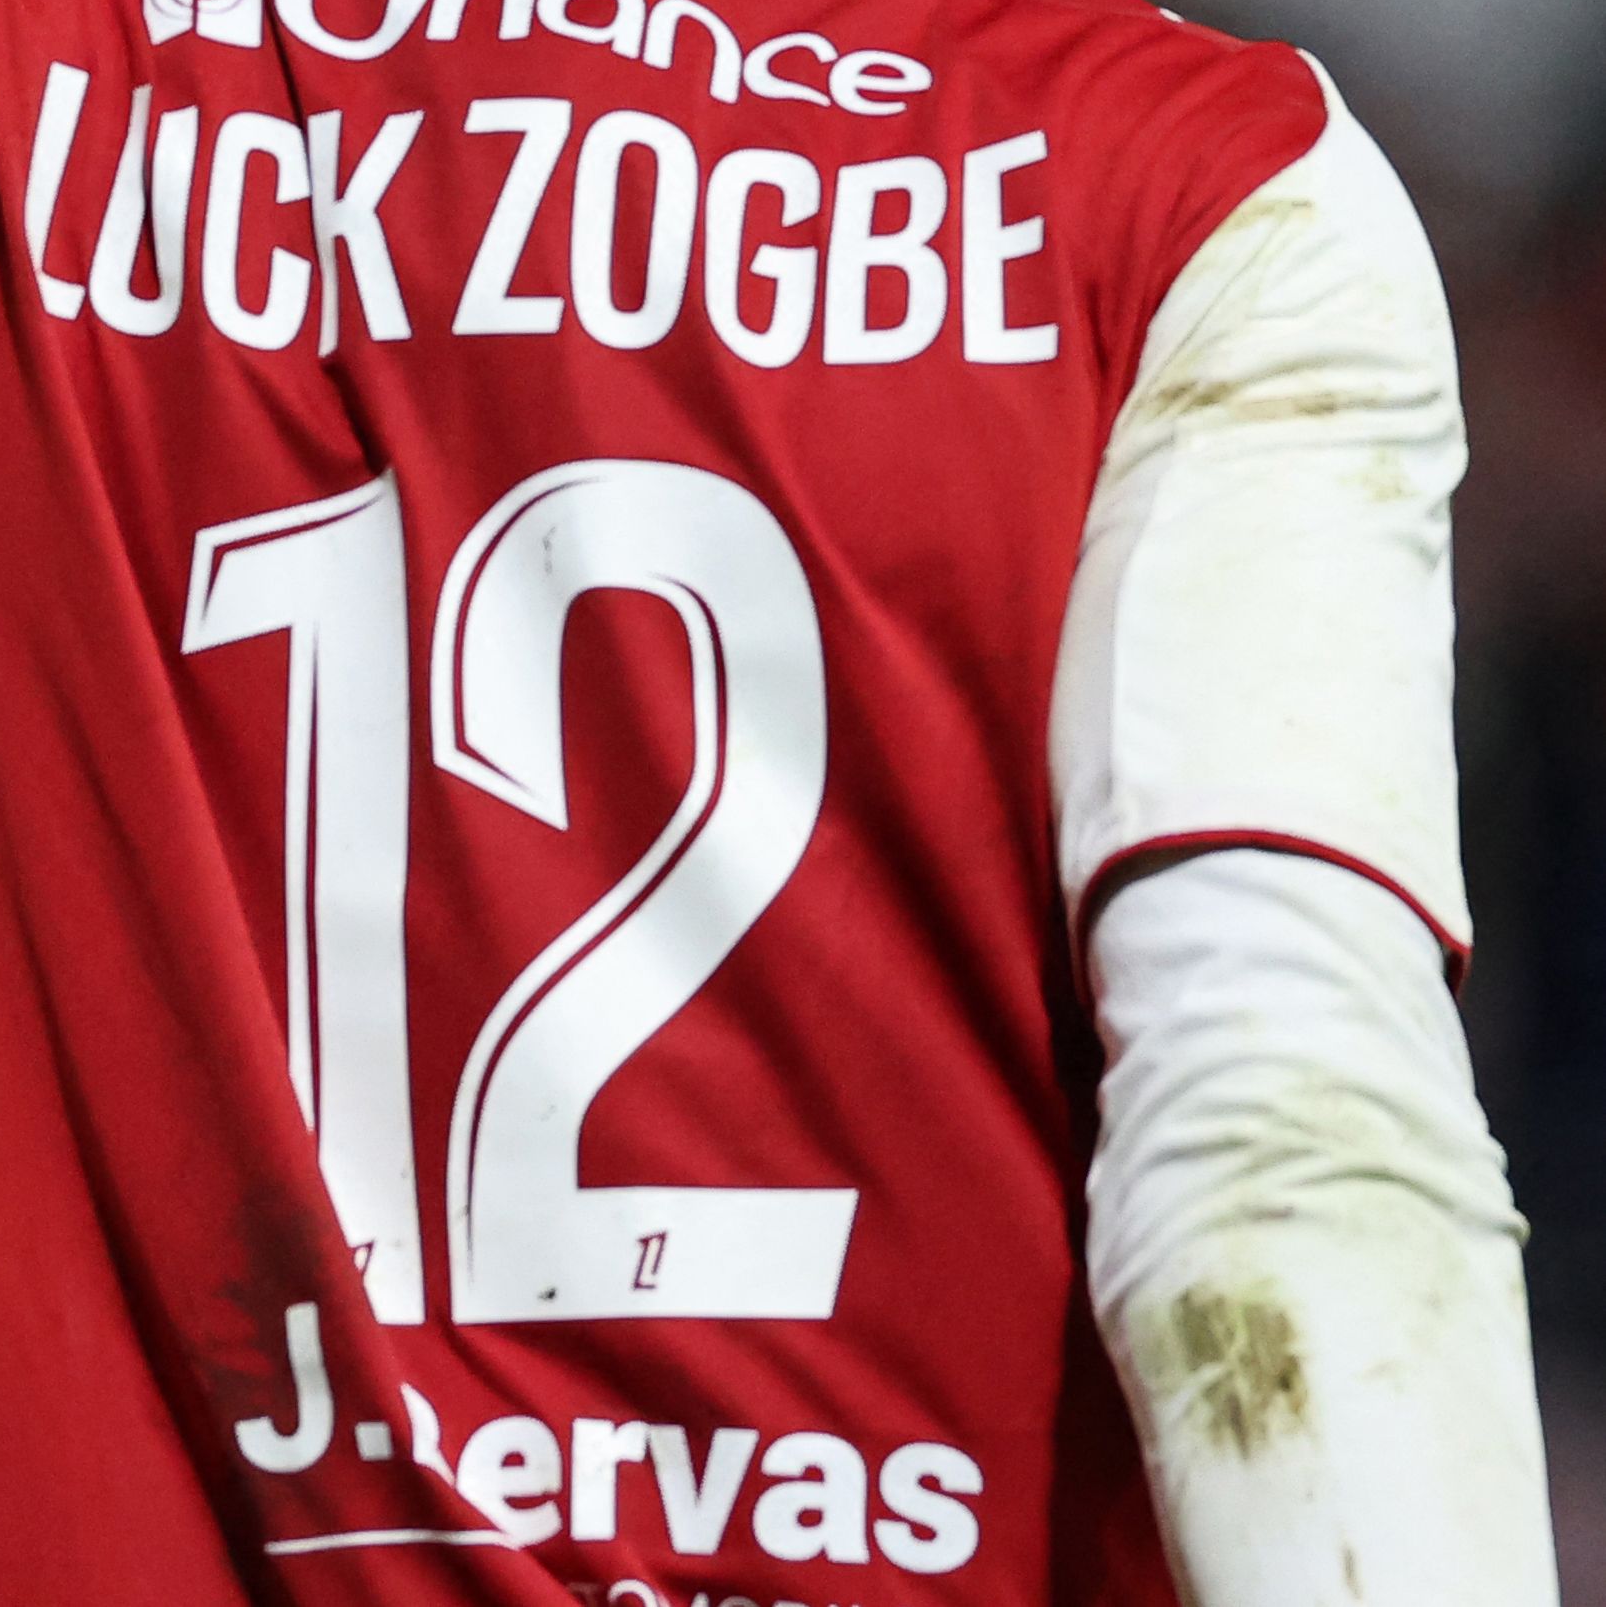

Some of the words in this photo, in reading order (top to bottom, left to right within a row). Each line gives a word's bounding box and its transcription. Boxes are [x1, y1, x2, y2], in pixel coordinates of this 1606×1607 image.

[24, 61, 425, 358] LUCK
[451, 97, 1060, 369] ZOGBE
[180, 458, 859, 1326] 12
